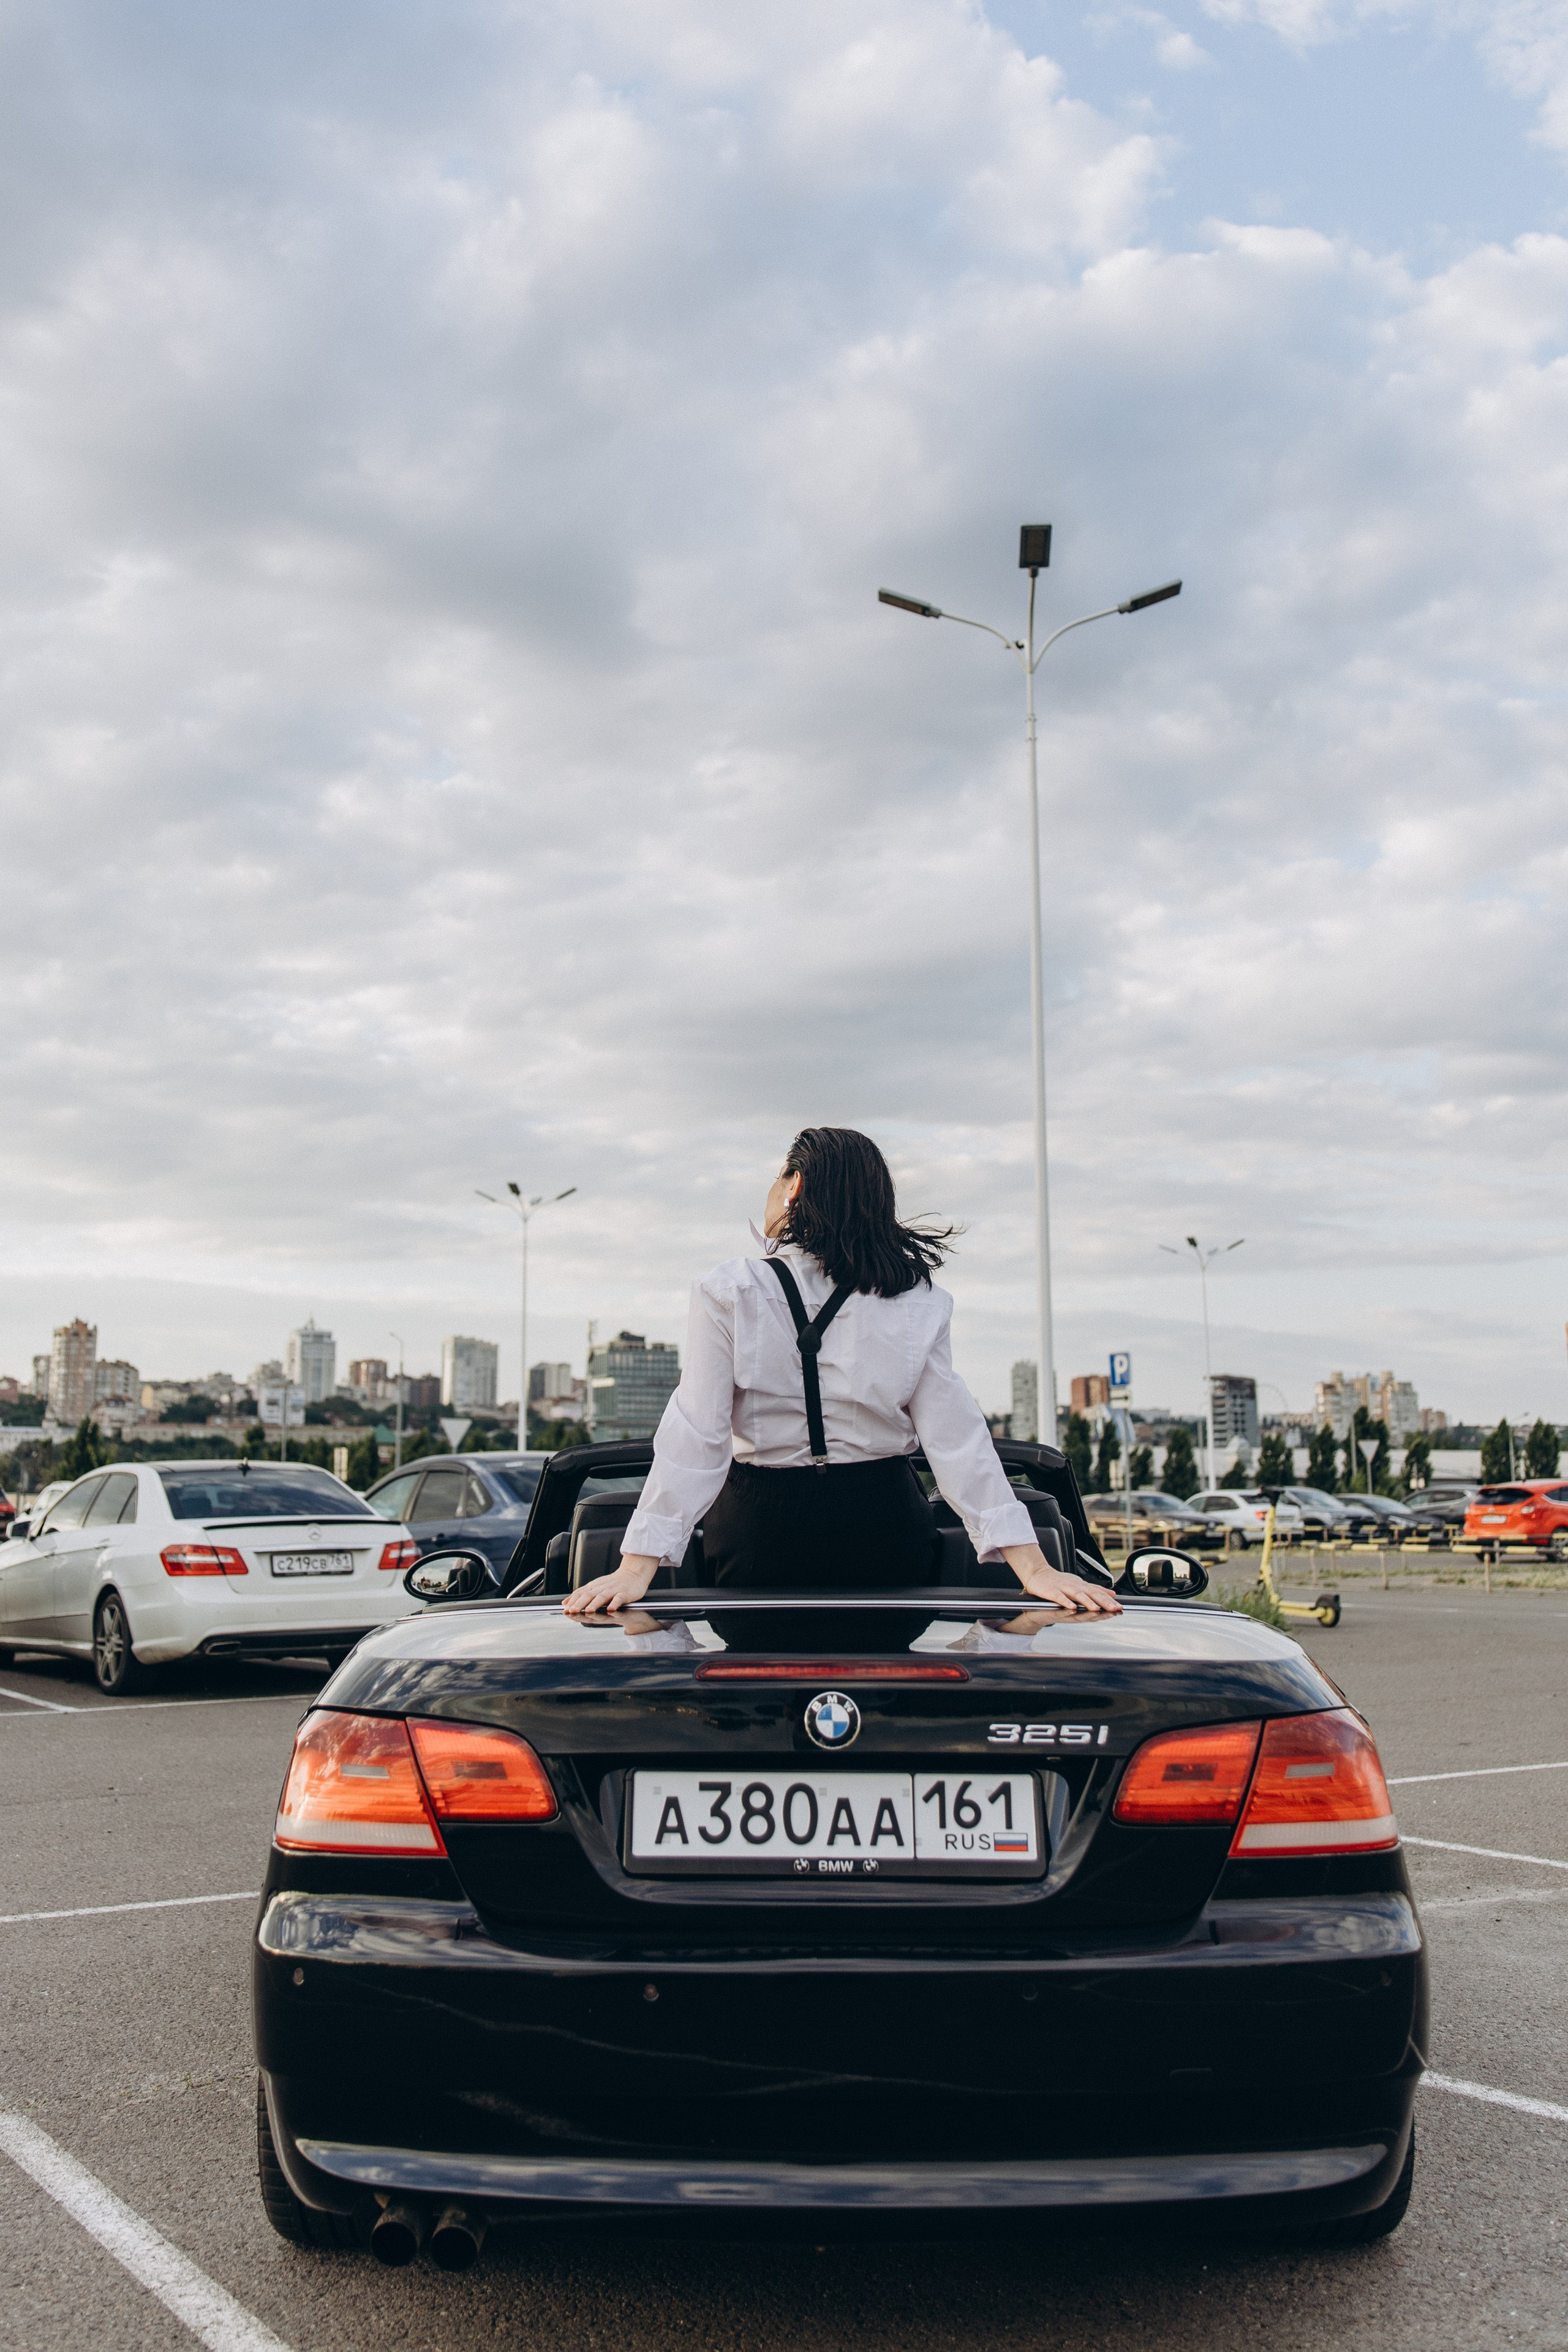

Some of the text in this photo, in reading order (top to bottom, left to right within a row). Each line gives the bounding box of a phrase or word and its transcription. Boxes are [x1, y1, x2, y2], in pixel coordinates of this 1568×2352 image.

[1114, 1355, 1127, 1384] P
[811, 1694, 854, 1713] BMW
[655, 1780, 1013, 1846] А380АА 161
[945, 1833, 991, 1850] RUS
[818, 1860, 854, 1873] BMW
